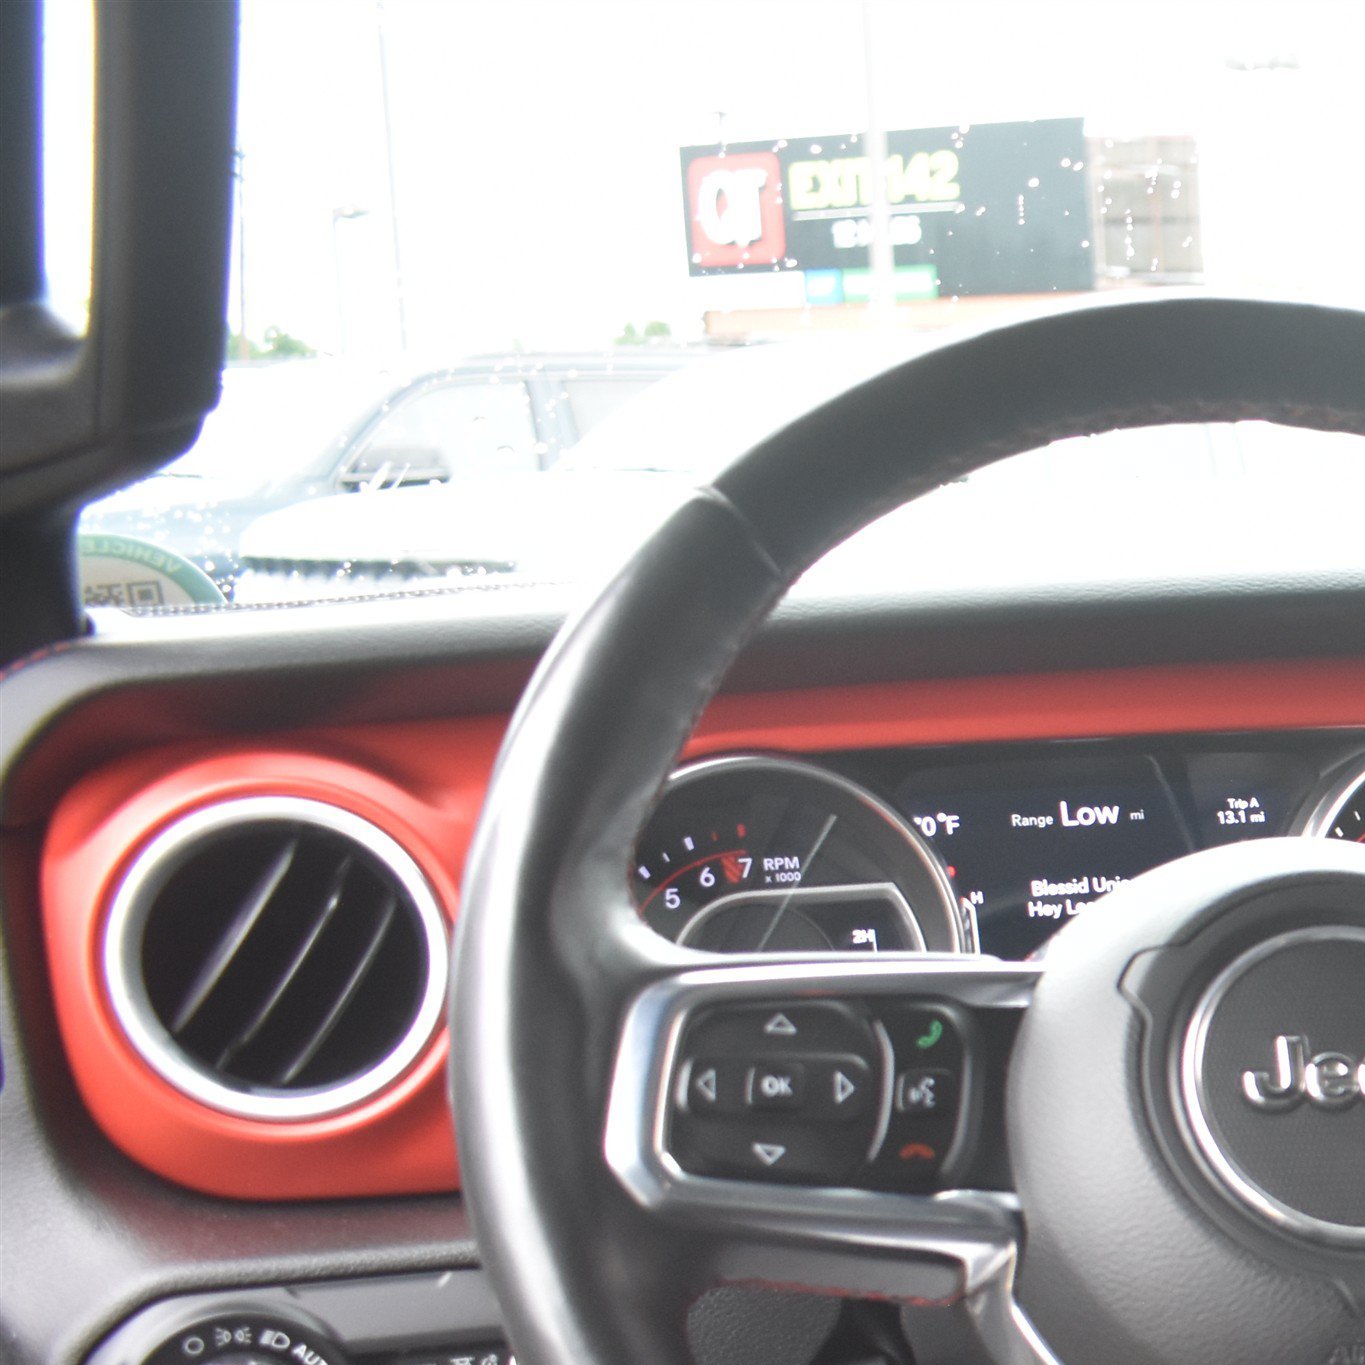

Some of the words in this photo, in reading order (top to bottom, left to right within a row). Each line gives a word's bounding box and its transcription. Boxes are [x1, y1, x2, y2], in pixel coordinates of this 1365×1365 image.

[1227, 798, 1248, 809] Trip
[1249, 797, 1259, 808] A
[912, 812, 960, 837] 0°F
[1011, 814, 1053, 829] Range
[1130, 809, 1144, 820] mi
[1217, 810, 1246, 824] 13.1
[1250, 811, 1265, 822] mi
[738, 858, 752, 878] 7
[763, 857, 799, 871] RPM
[700, 867, 715, 887] 6
[775, 871, 801, 883] 1000
[1031, 876, 1089, 897] Blessid
[665, 889, 680, 909] 5
[970, 891, 984, 904] H
[1028, 900, 1063, 919] Hey
[760, 1076, 793, 1098] OK
